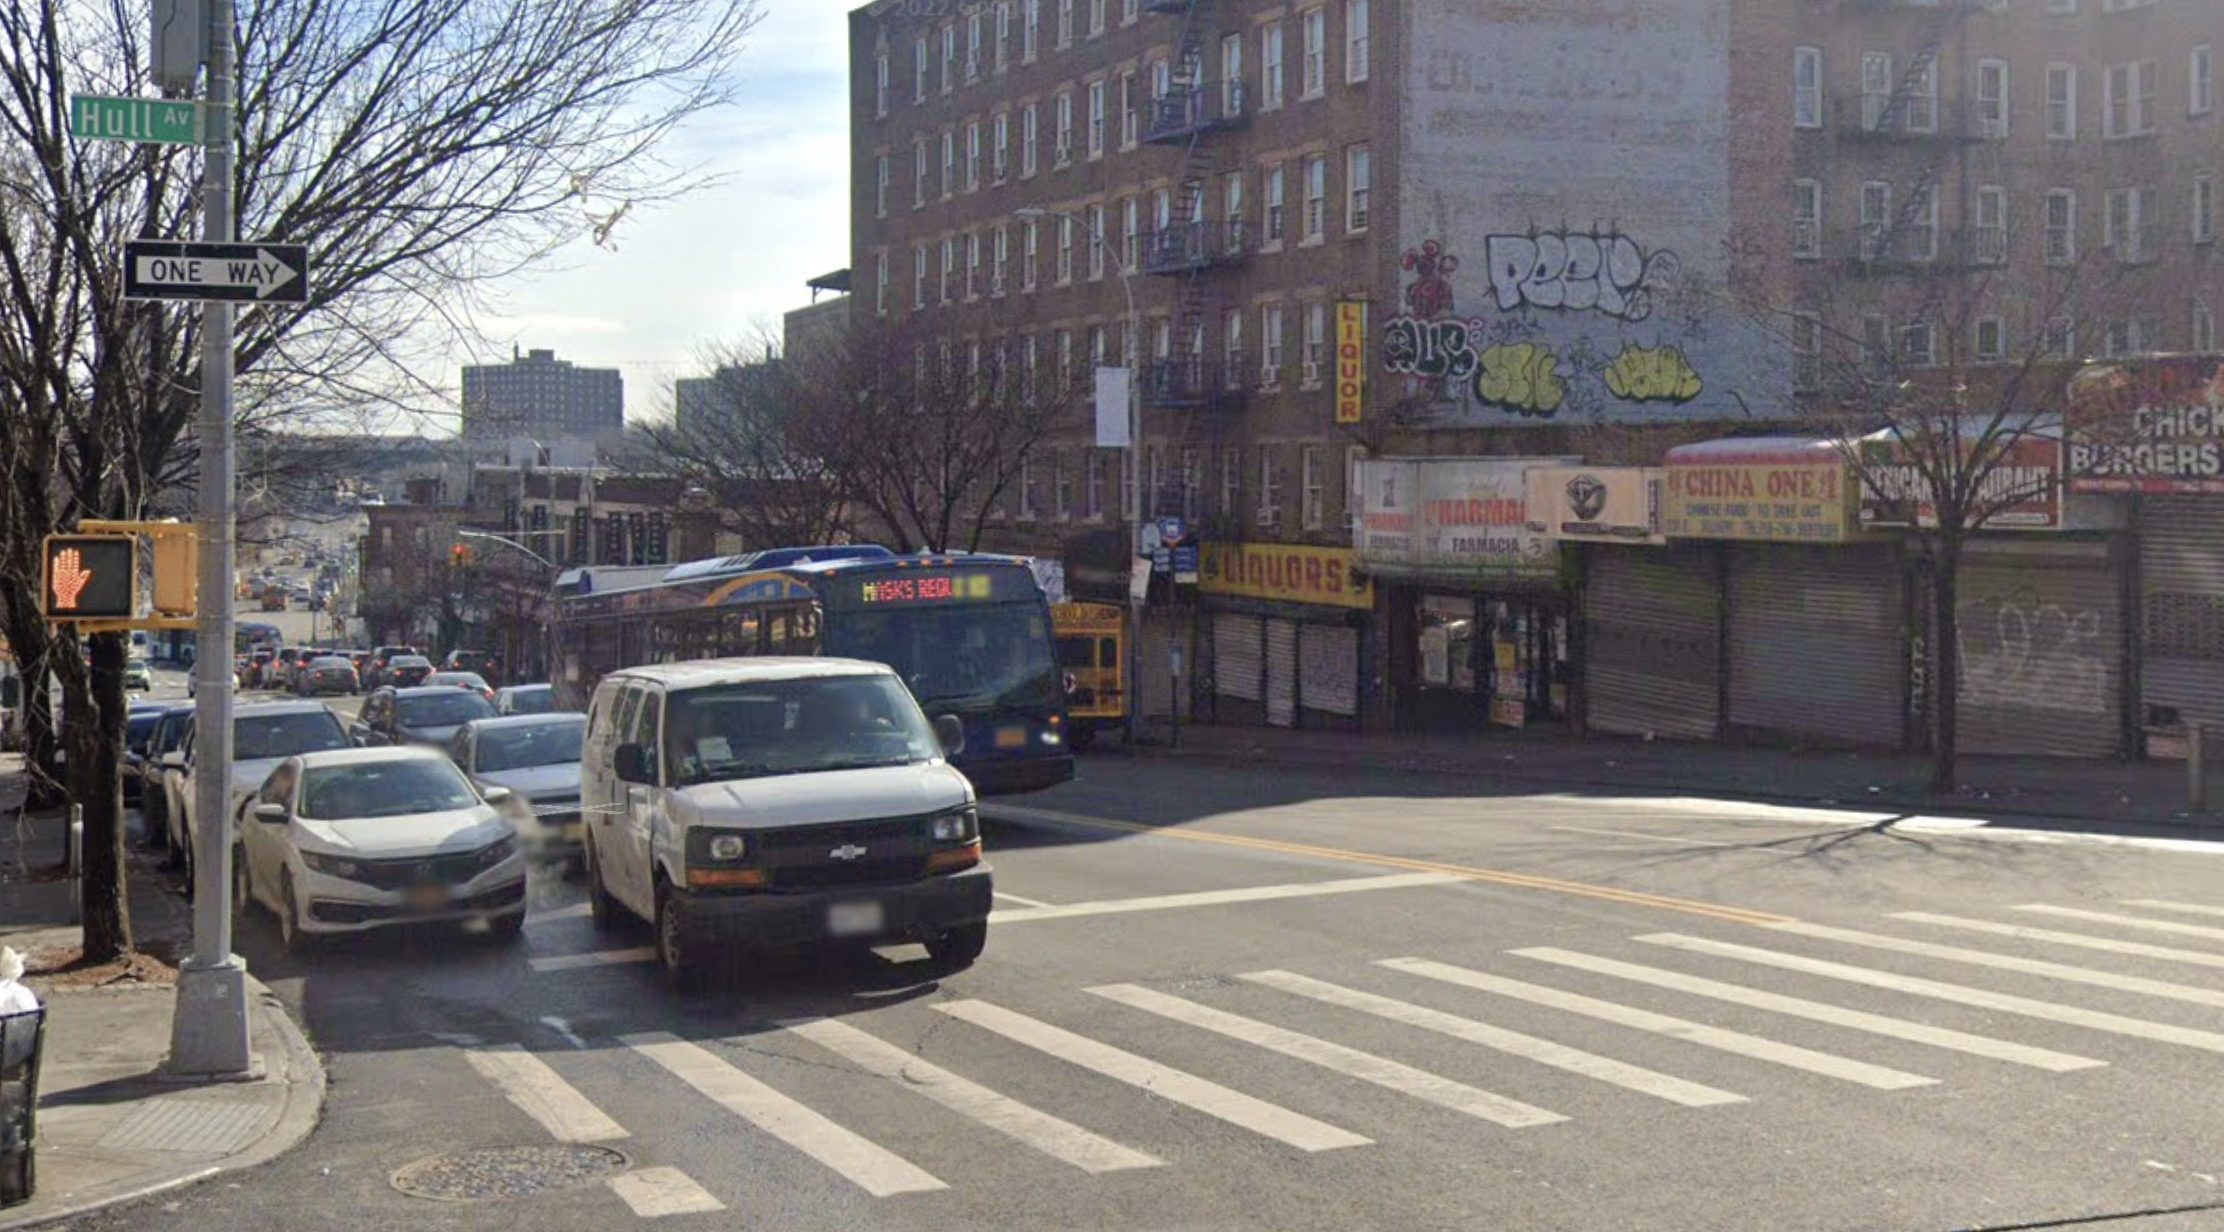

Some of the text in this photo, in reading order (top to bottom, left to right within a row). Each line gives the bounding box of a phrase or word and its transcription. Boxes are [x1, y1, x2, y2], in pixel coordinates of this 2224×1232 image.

[80, 102, 189, 138] Hull AV
[150, 259, 280, 285] ONE WAY
[1340, 304, 1358, 418] LIQUOR
[2069, 444, 2220, 476] BURGERS
[1685, 469, 1755, 498] CHINA
[1767, 470, 1815, 499] ONE
[1452, 536, 1520, 553] FARMACIA
[1223, 550, 1344, 594] LIQUORS
